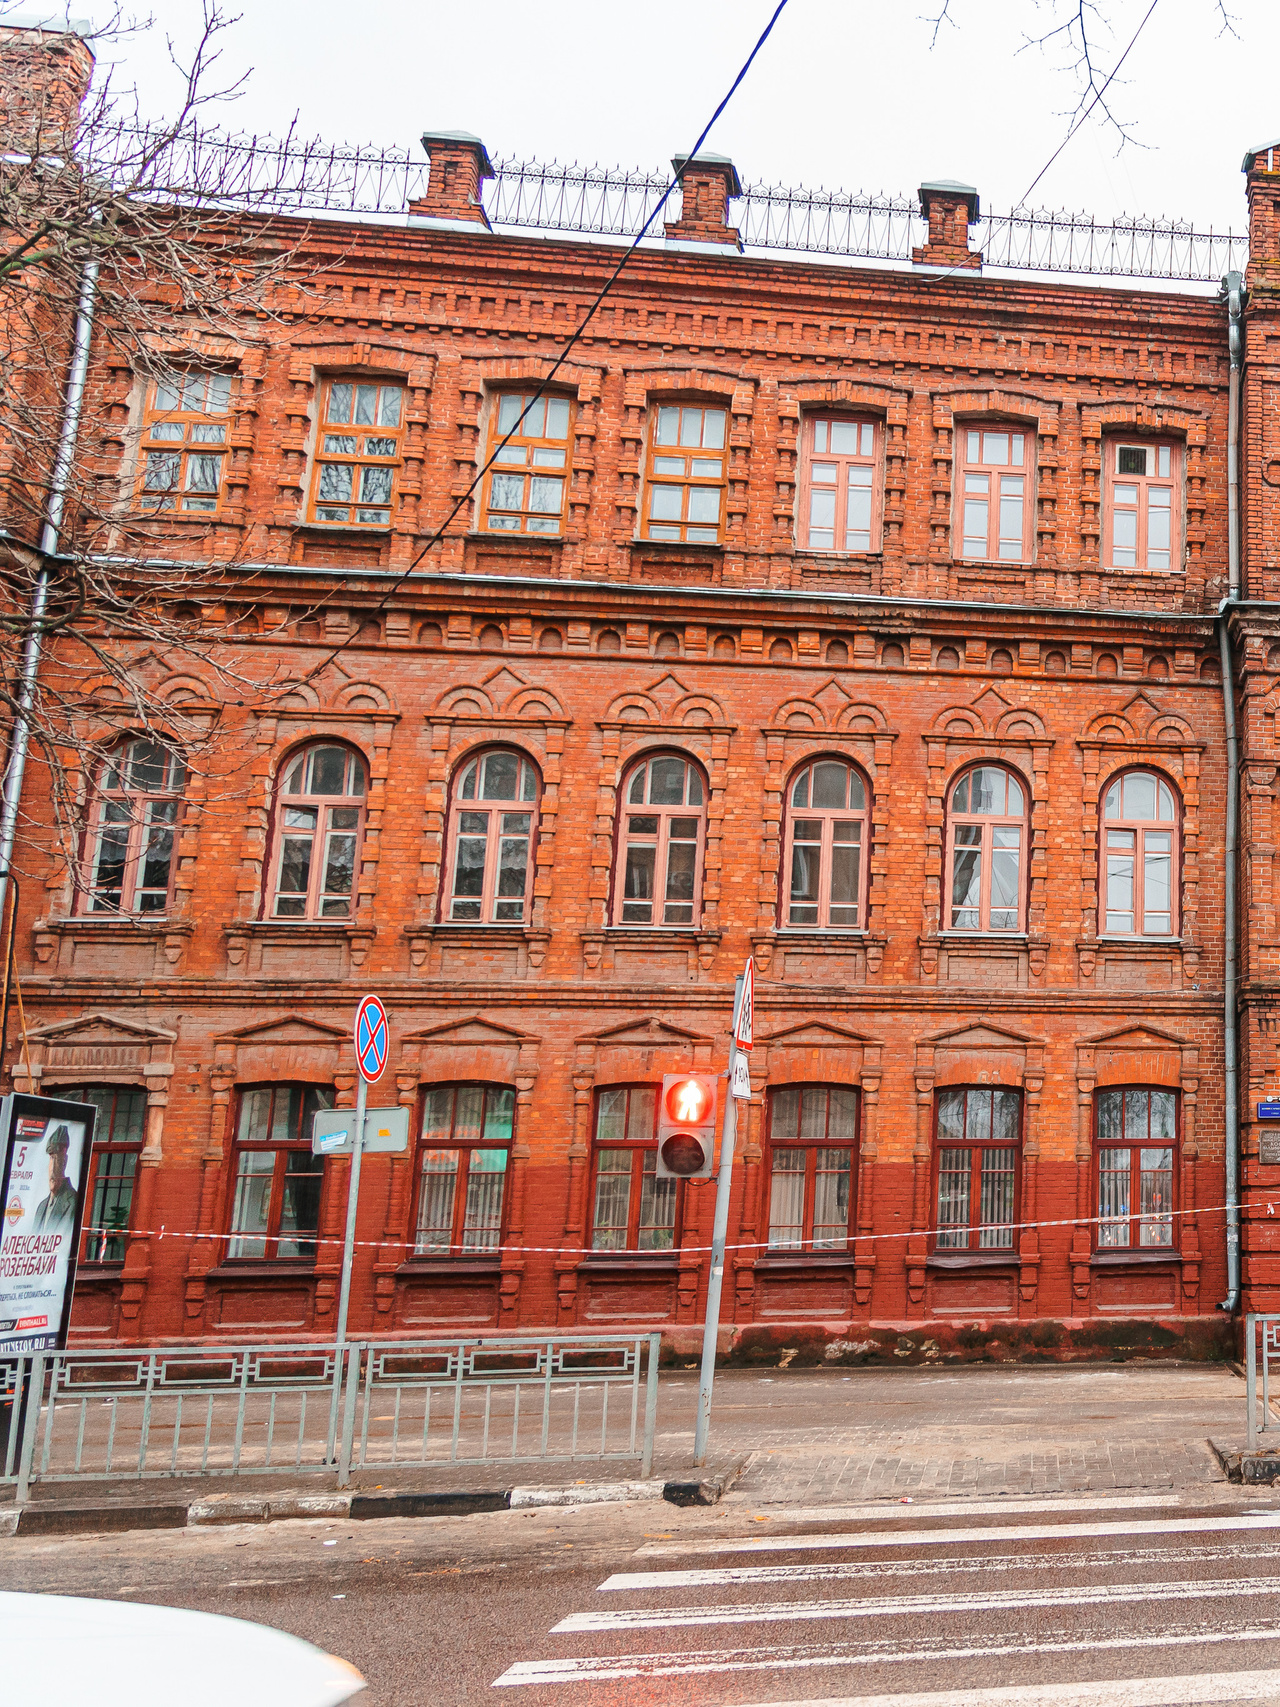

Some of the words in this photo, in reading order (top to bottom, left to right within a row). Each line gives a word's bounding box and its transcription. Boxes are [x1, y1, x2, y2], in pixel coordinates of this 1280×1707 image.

[17, 1146, 27, 1167] 5
[10, 1170, 33, 1180] ЕВРАЛЯ
[1, 1234, 62, 1255] АЛЕКСАНДР
